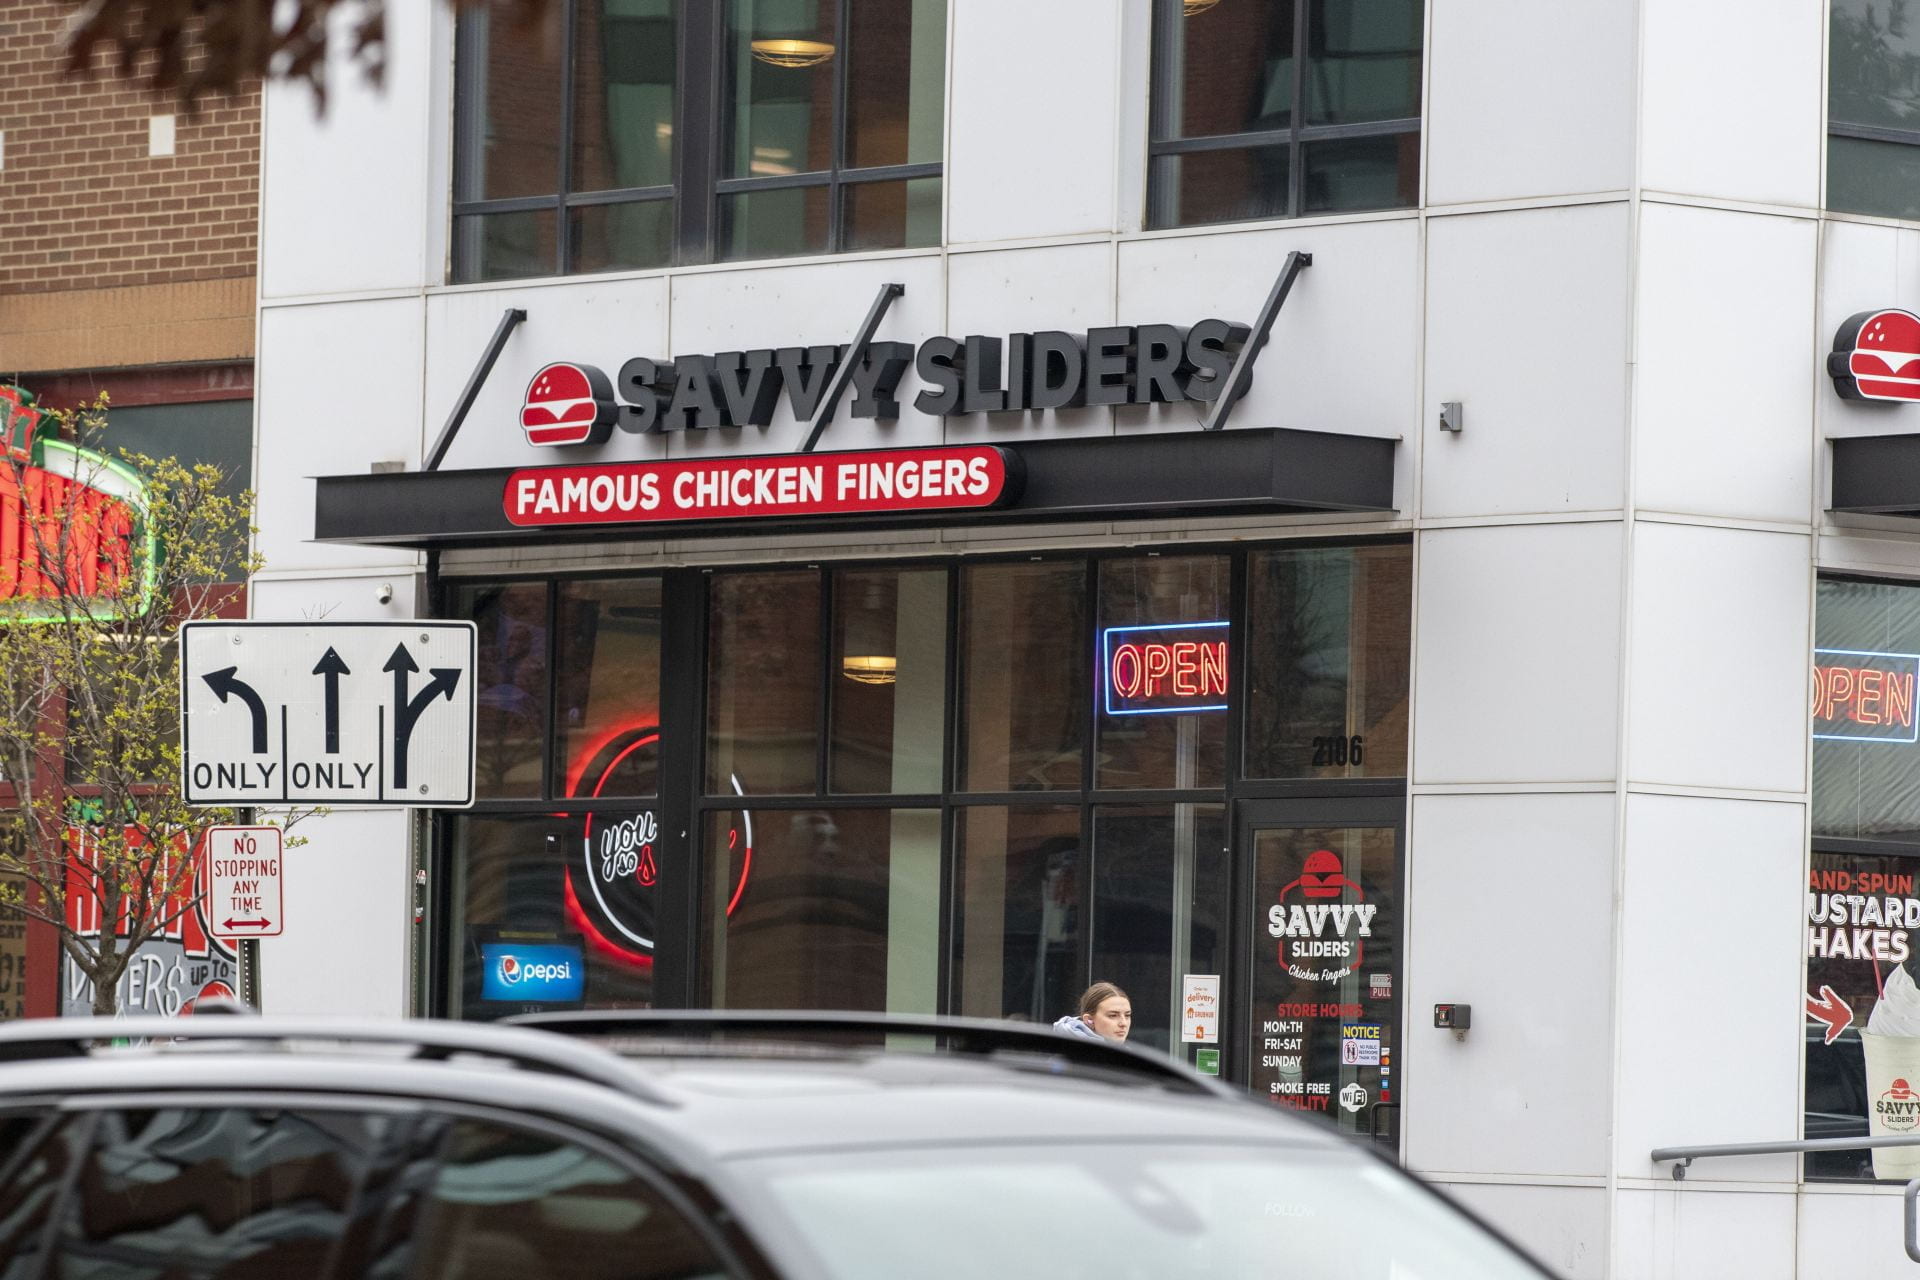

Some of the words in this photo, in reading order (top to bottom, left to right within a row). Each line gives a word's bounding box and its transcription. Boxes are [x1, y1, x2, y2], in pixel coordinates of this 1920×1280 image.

[617, 342, 915, 433] SAVVY
[913, 319, 1252, 416] SLIDERS
[517, 473, 660, 515] FAMOUS
[673, 465, 822, 508] CHICKEN
[837, 456, 990, 501] FINGERS
[1113, 642, 1226, 698] OPEN
[1312, 735, 1363, 766] 2106
[193, 762, 277, 789] ONLY
[292, 762, 373, 789] ONLY
[234, 838, 257, 854] NO
[215, 860, 277, 877] STOPPING
[233, 881, 260, 894] ANY
[230, 897, 262, 911] TIME
[1268, 904, 1376, 937] SAVVY
[1292, 941, 1350, 957] SLIDERS
[191, 967, 208, 985] UP
[212, 960, 229, 978] TO
[524, 962, 571, 983] pepsi
[1288, 964, 1320, 981] Chicken
[1321, 967, 1351, 986] Fingers
[1187, 991, 1215, 1005] delivery
[1373, 987, 1391, 997] PULL
[1278, 1004, 1317, 1017] STORE
[1320, 1003, 1364, 1017] HOURS
[1264, 1021, 1303, 1033] MON-TH
[1343, 1027, 1380, 1038] NOTICE
[1264, 1038, 1302, 1050] FRI-SAT
[1263, 1056, 1302, 1067] SUNDAY
[1271, 1082, 1303, 1094] SMOKE
[1307, 1083, 1330, 1094] FREE
